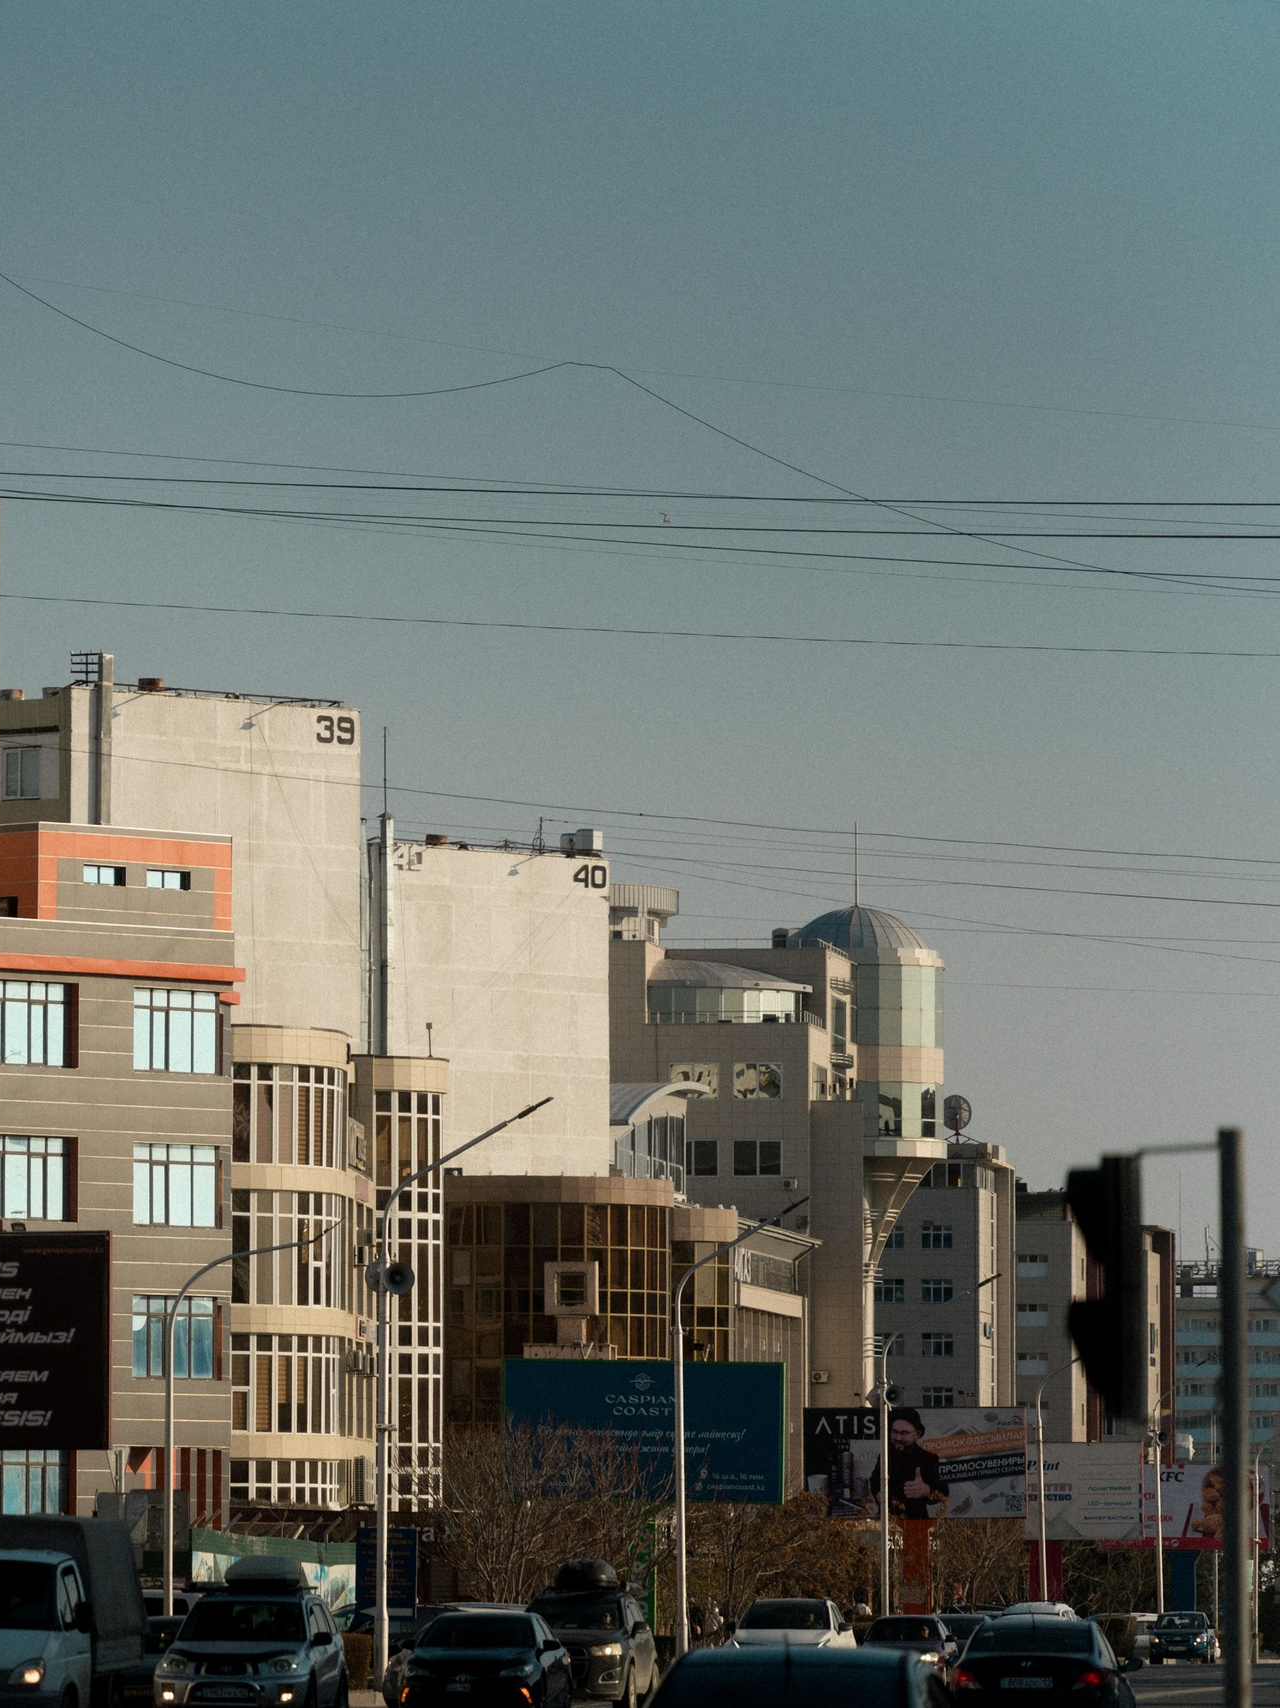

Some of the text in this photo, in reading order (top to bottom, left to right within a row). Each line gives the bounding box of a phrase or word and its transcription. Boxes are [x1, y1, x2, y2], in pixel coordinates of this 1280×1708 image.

[316, 715, 355, 745] 39
[573, 865, 606, 889] 40
[605, 1394, 676, 1405] CASPIAN
[613, 1406, 673, 1416] COAST
[815, 1415, 876, 1435] ATIS
[938, 1456, 1025, 1474] ПРОМОСУВЕНИРЫ
[707, 1483, 766, 1492] caspiancoast.kz
